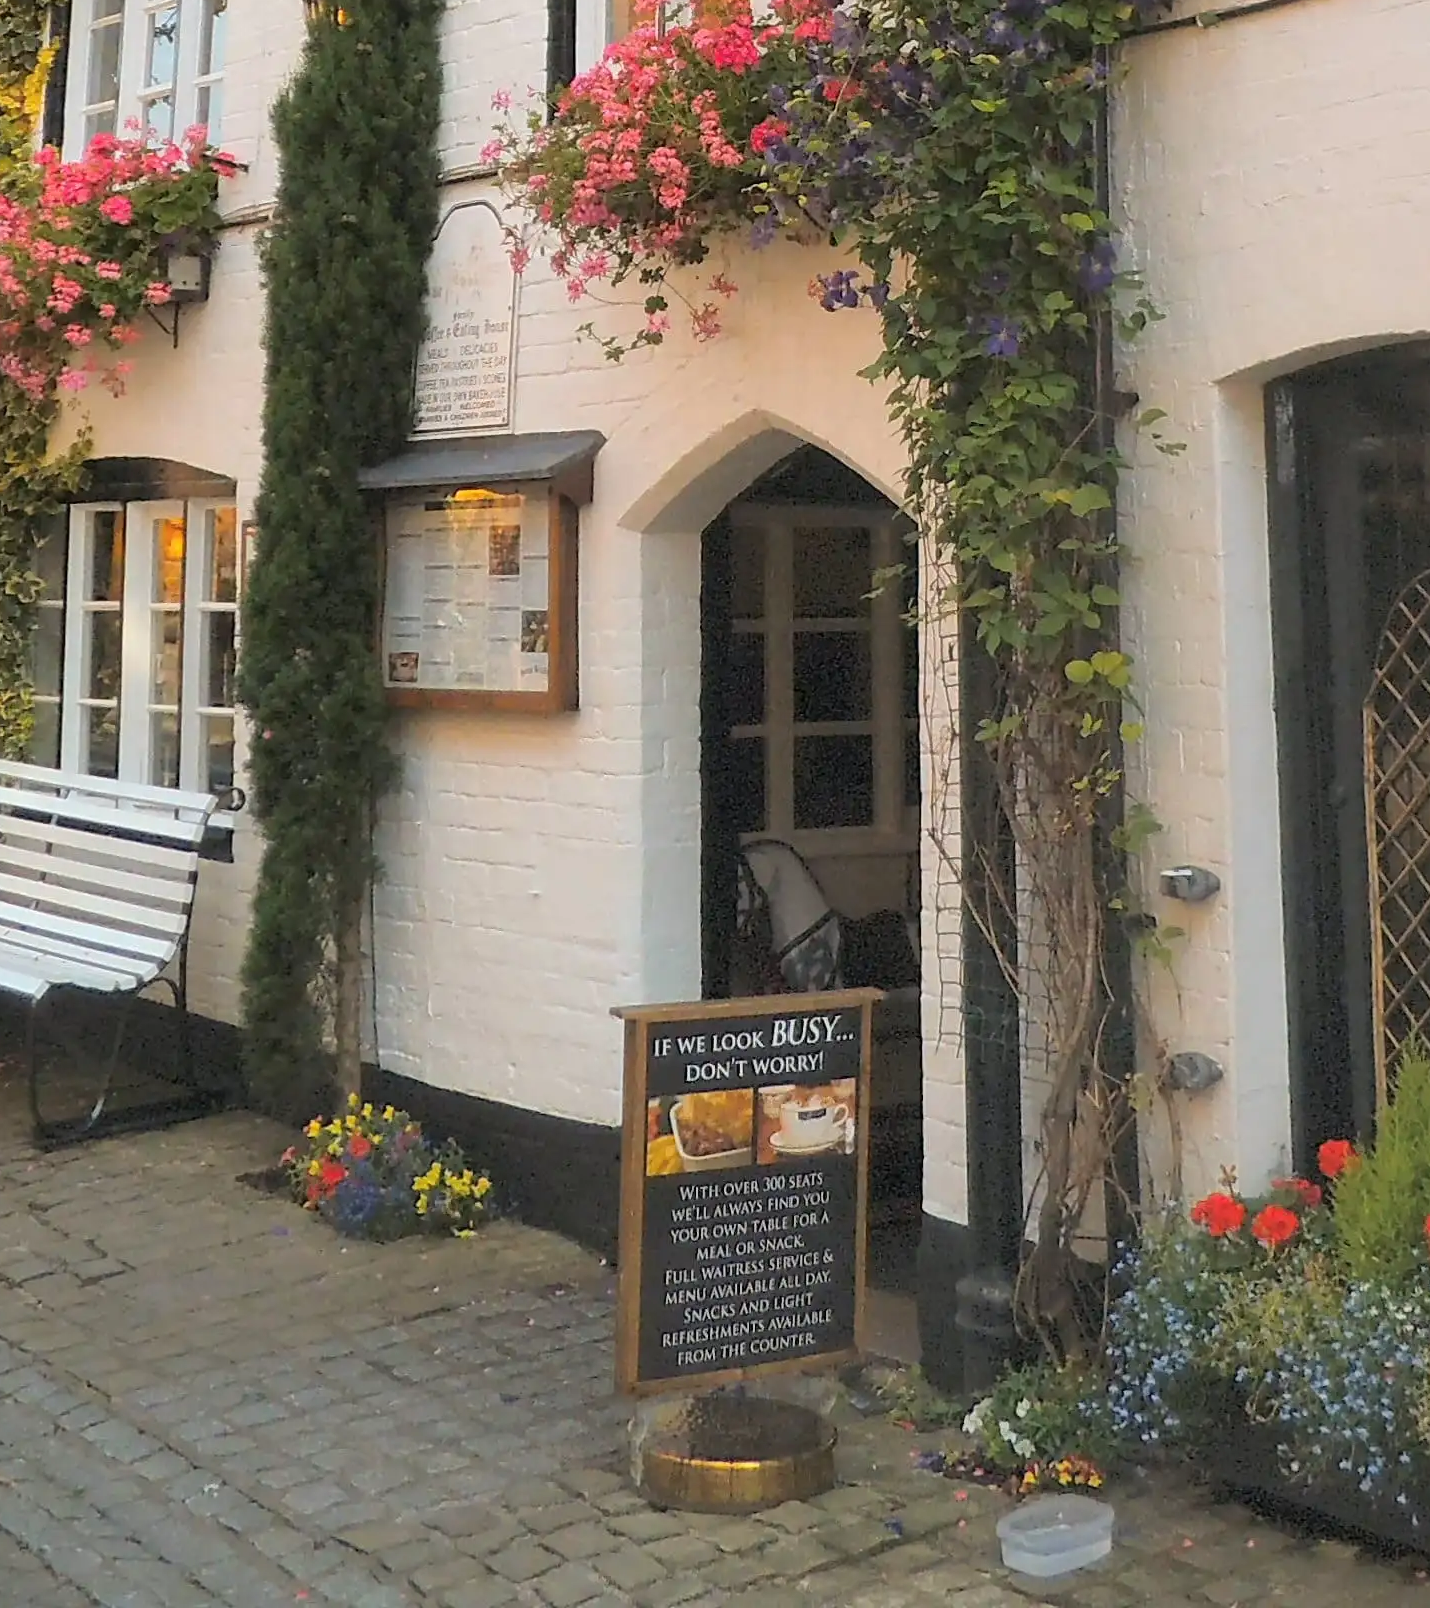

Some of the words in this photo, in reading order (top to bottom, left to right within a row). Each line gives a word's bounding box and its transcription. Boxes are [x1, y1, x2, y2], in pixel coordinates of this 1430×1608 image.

[654, 1038, 671, 1057] IF
[678, 1035, 706, 1055] WE
[712, 1031, 765, 1053] LOOK
[771, 1015, 854, 1048] BUSY...
[685, 1058, 748, 1082] DON'T
[751, 1051, 824, 1076] WORRY!
[679, 1184, 719, 1201] WITH
[723, 1179, 759, 1196] OVER
[763, 1175, 786, 1192] 300
[788, 1172, 824, 1189] SEATS
[671, 1204, 710, 1222] WE'LL
[713, 1199, 763, 1217] ALWAYS
[767, 1194, 801, 1212] FIND
[802, 1191, 830, 1206] YOU
[670, 1226, 709, 1244] YOUR
[713, 1221, 748, 1238] OWN
[751, 1216, 788, 1234] TABLE
[792, 1212, 818, 1228] FOR
[821, 1210, 830, 1224] A
[665, 1268, 697, 1286] FULL
[701, 1259, 764, 1281] WAITRESS
[768, 1251, 820, 1271] SERVICE
[822, 1248, 834, 1263] &
[696, 1244, 732, 1261] MEAL
[735, 1240, 756, 1256] OR
[665, 1287, 707, 1305] MENU
[709, 1278, 775, 1300] AVAILABLE
[779, 1275, 801, 1289] ALL
[805, 1270, 832, 1285] DAY.
[683, 1303, 736, 1325] SNACKS
[739, 1298, 770, 1316] AND
[774, 1292, 814, 1310] LIGHT
[662, 1319, 765, 1348] REFRESHMENTS
[767, 1308, 833, 1332] AVAILABLE
[677, 1347, 717, 1366] FROM
[720, 1342, 747, 1360] THE
